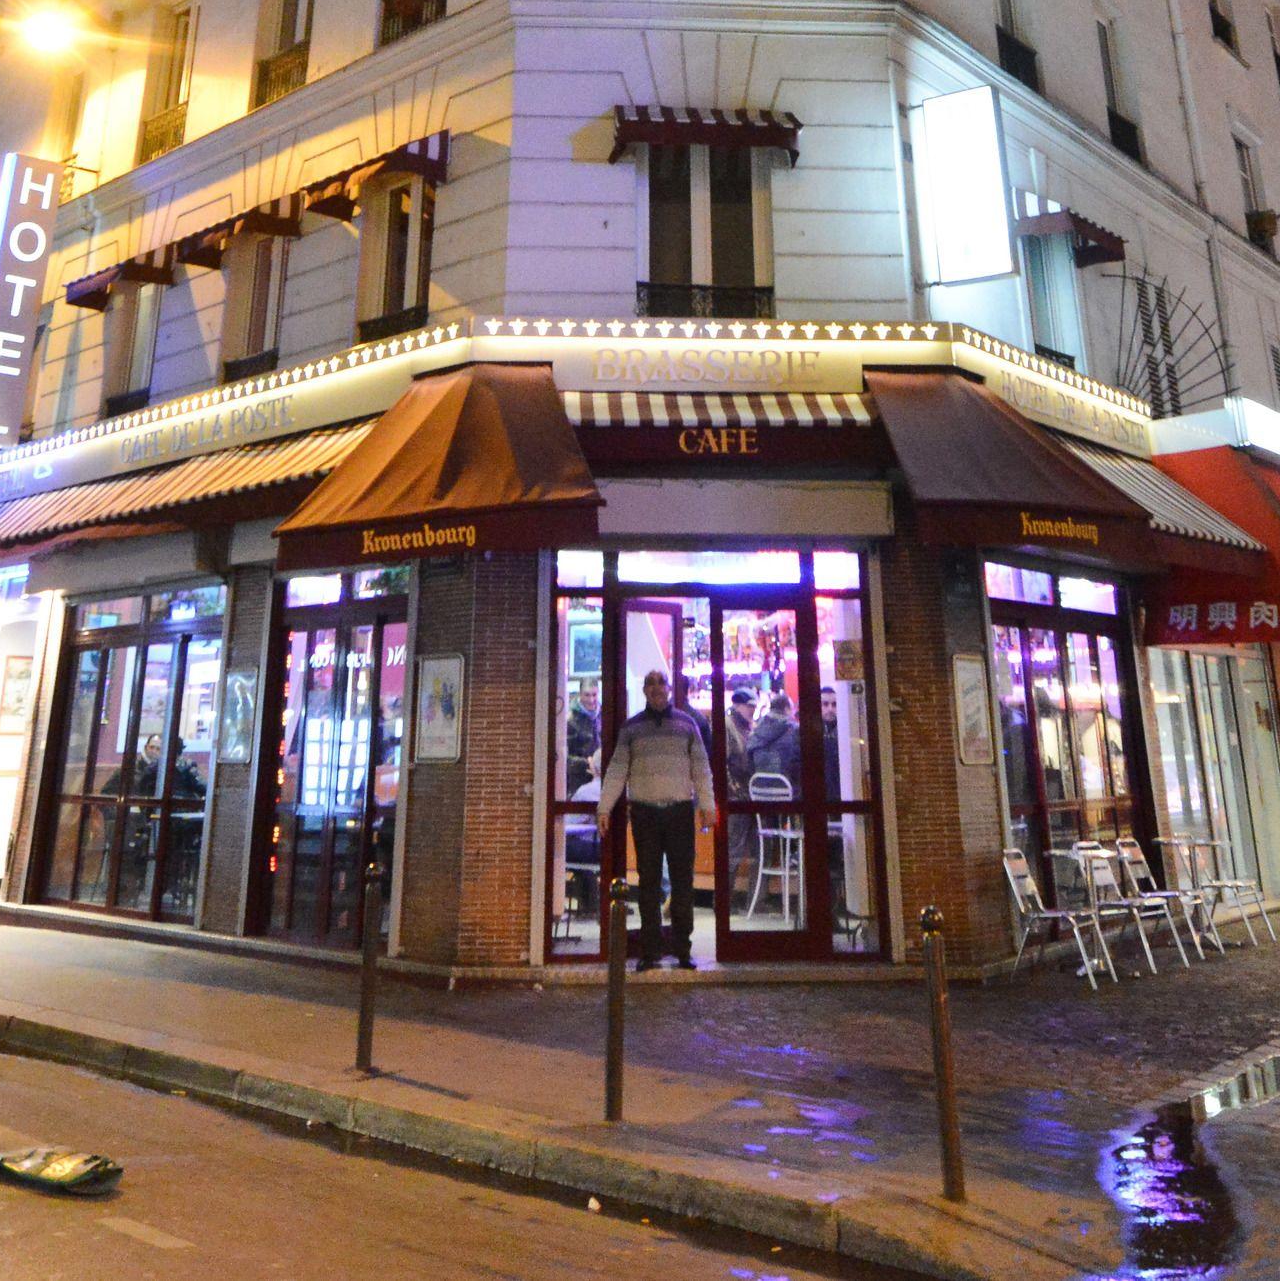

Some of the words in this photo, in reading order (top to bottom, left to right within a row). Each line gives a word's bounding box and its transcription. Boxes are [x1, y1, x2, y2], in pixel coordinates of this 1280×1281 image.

[593, 348, 821, 385] BRASSERIE
[172, 421, 196, 452] DE
[199, 414, 225, 444] LA
[230, 395, 295, 437] POSTE
[362, 523, 476, 555] Kronenbourg
[1020, 511, 1099, 546] Kronenbourg
